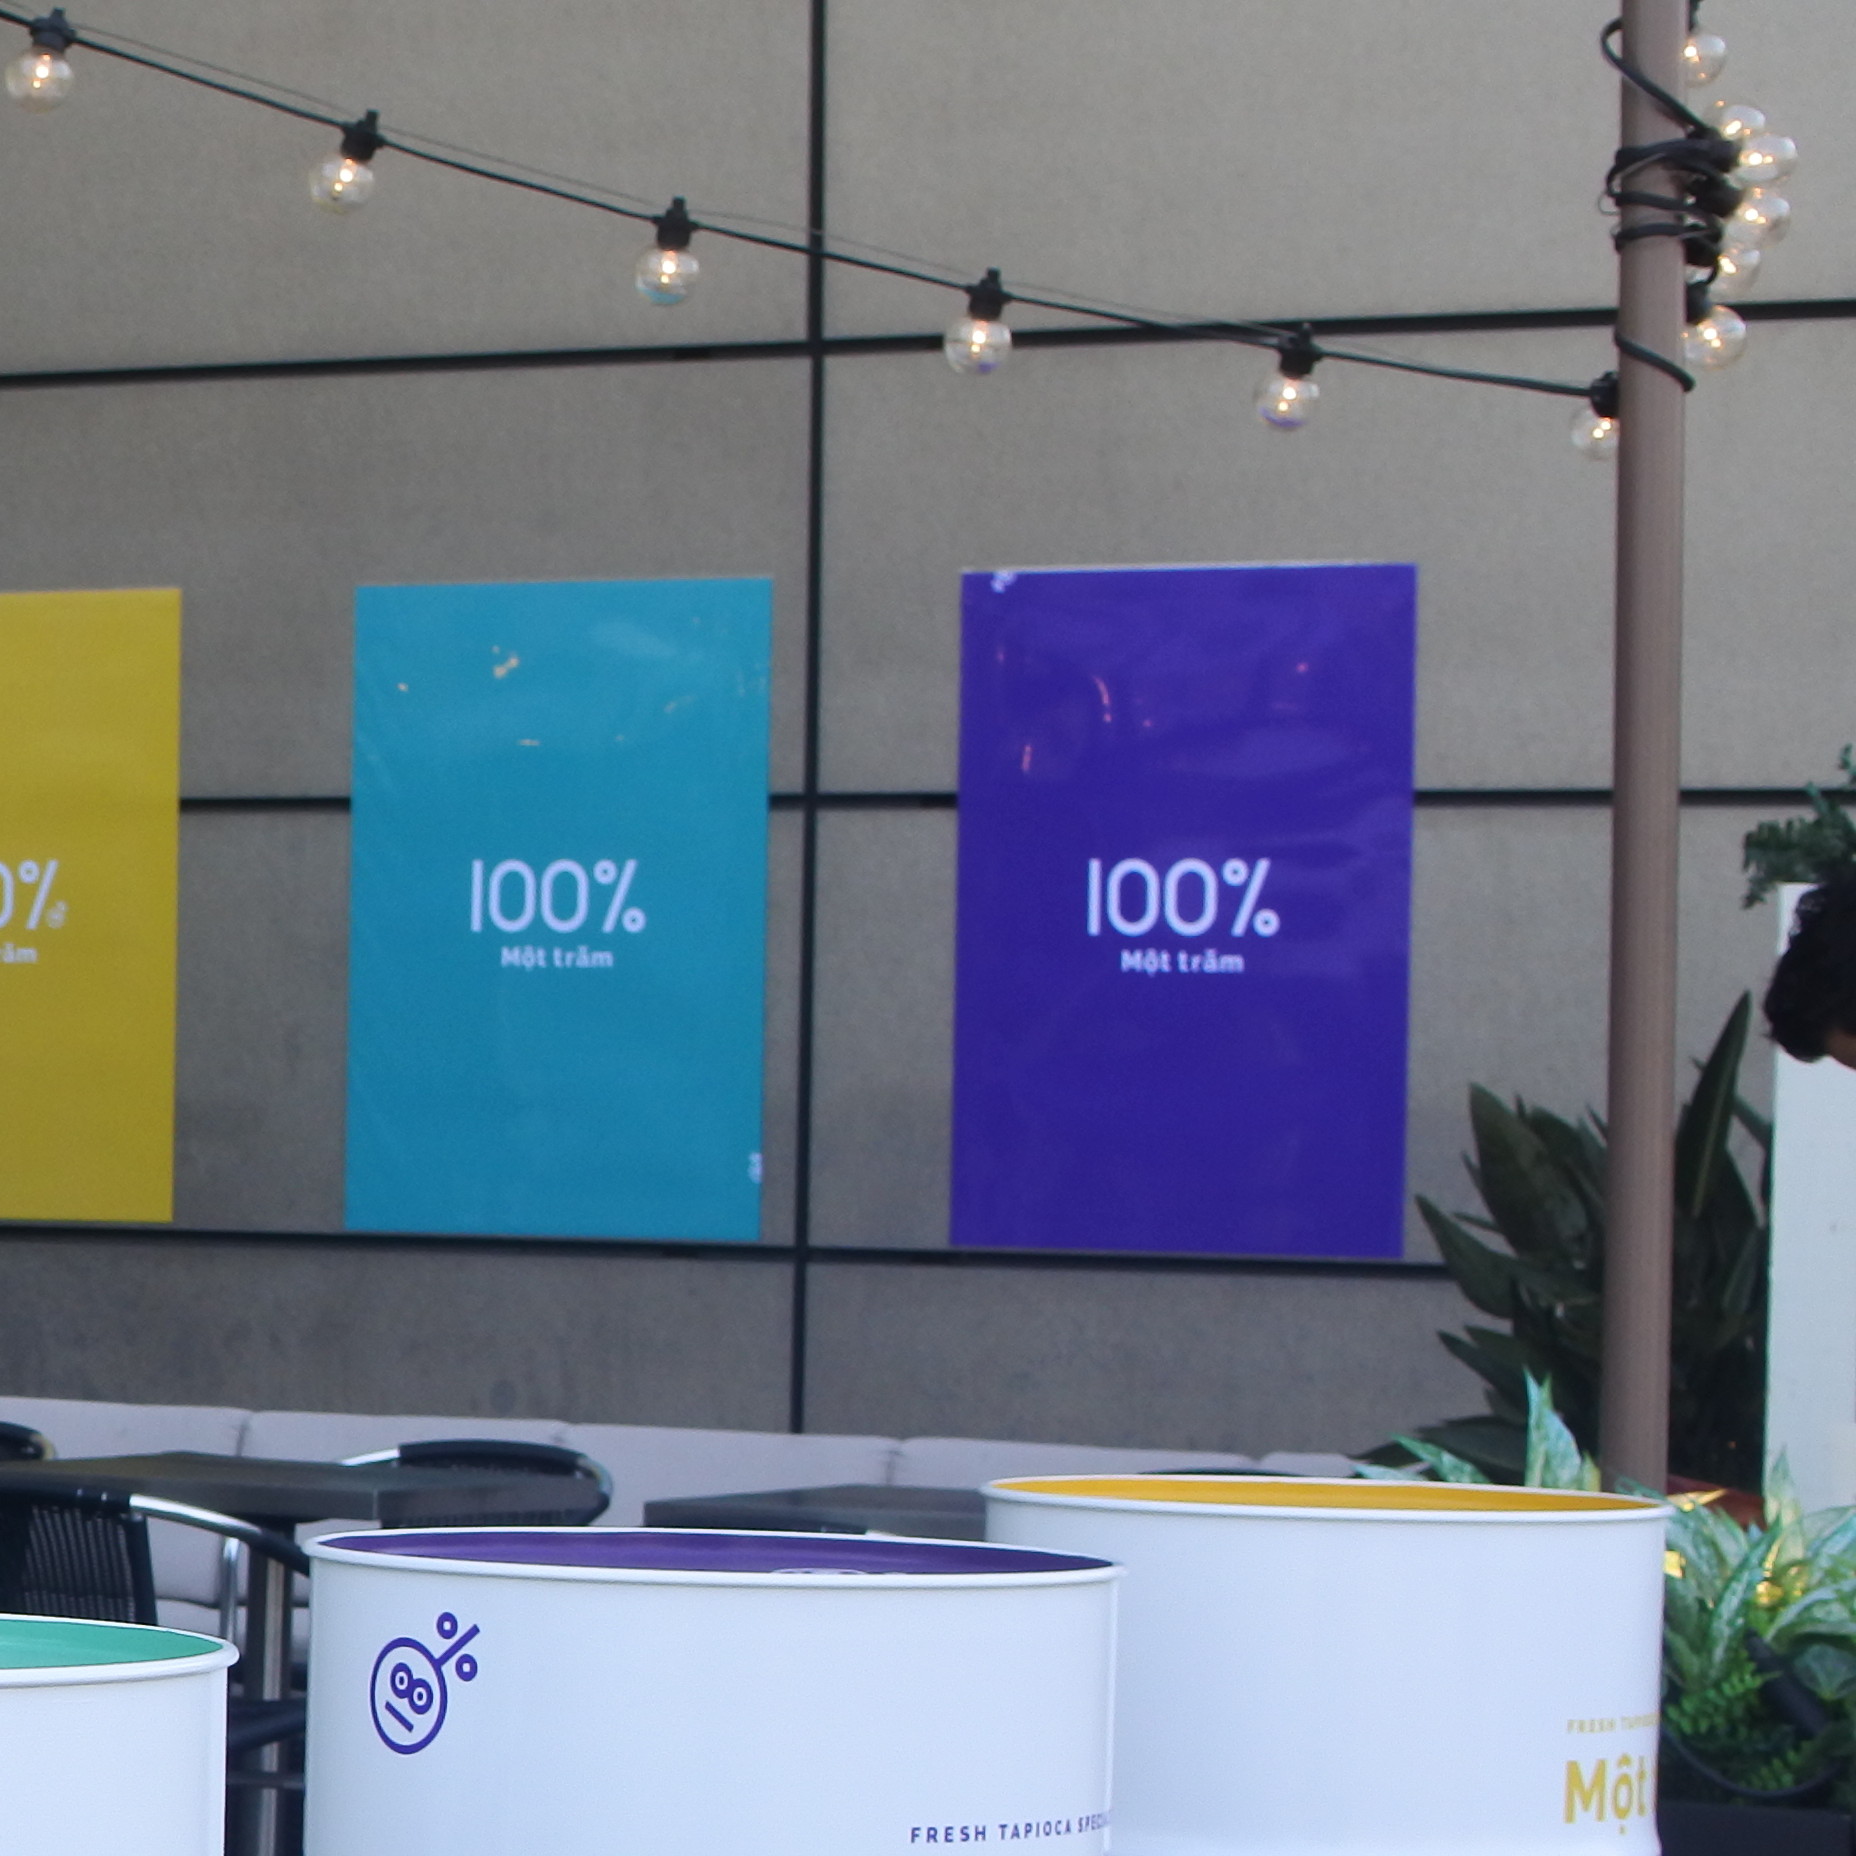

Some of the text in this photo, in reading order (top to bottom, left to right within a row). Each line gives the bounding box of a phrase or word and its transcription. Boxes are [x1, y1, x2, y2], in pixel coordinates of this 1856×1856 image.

[471, 859, 646, 933] 100%
[1087, 858, 1281, 937] 100%
[910, 1825, 987, 1843] FRESH
[999, 1819, 1072, 1841] TAPIOCA
